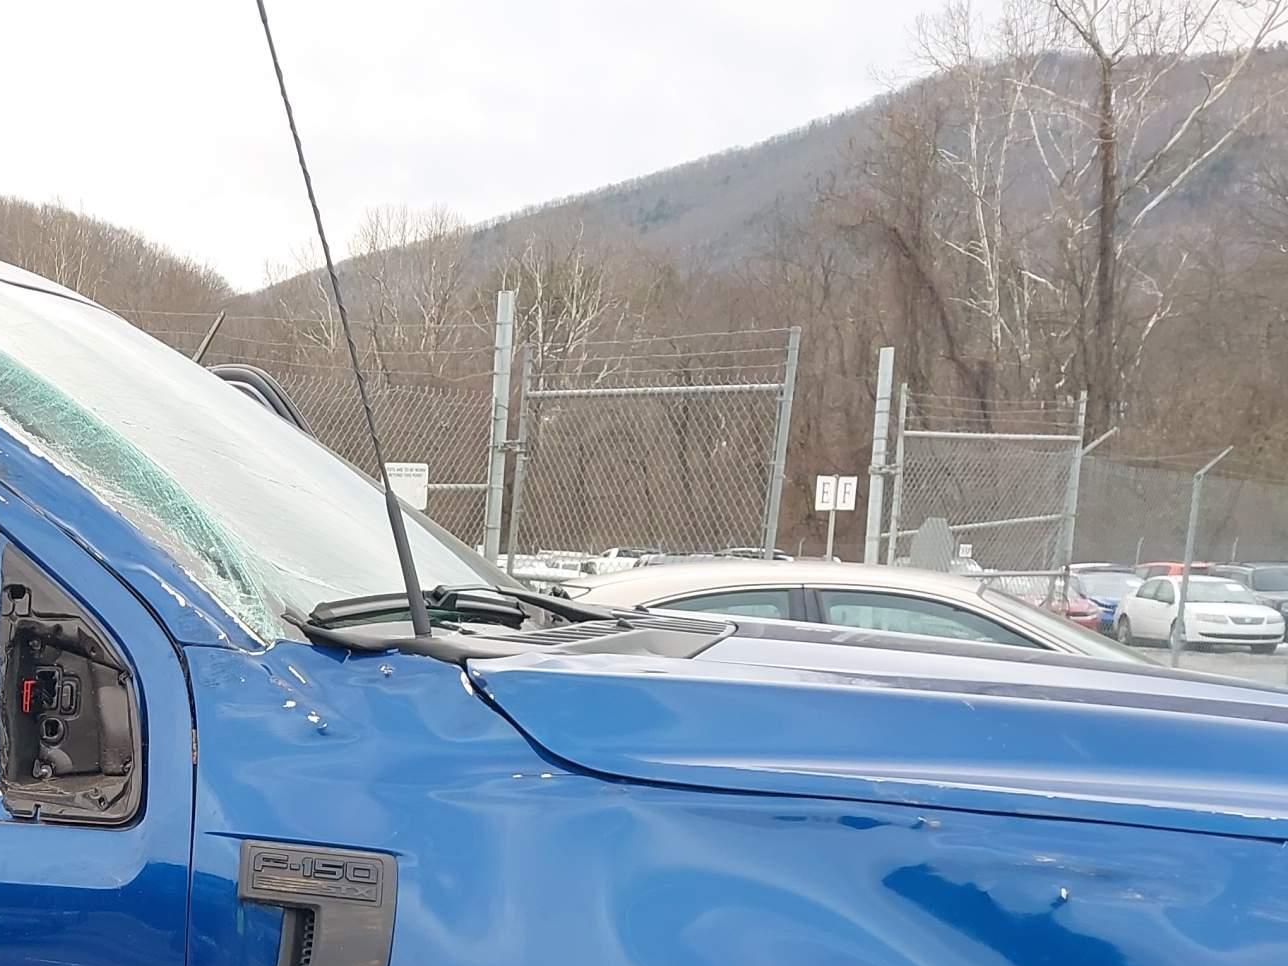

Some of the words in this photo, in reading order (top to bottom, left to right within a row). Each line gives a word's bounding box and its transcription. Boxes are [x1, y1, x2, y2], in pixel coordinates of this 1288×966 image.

[821, 482, 831, 504] E
[842, 482, 852, 504] F
[254, 853, 379, 884] F-150
